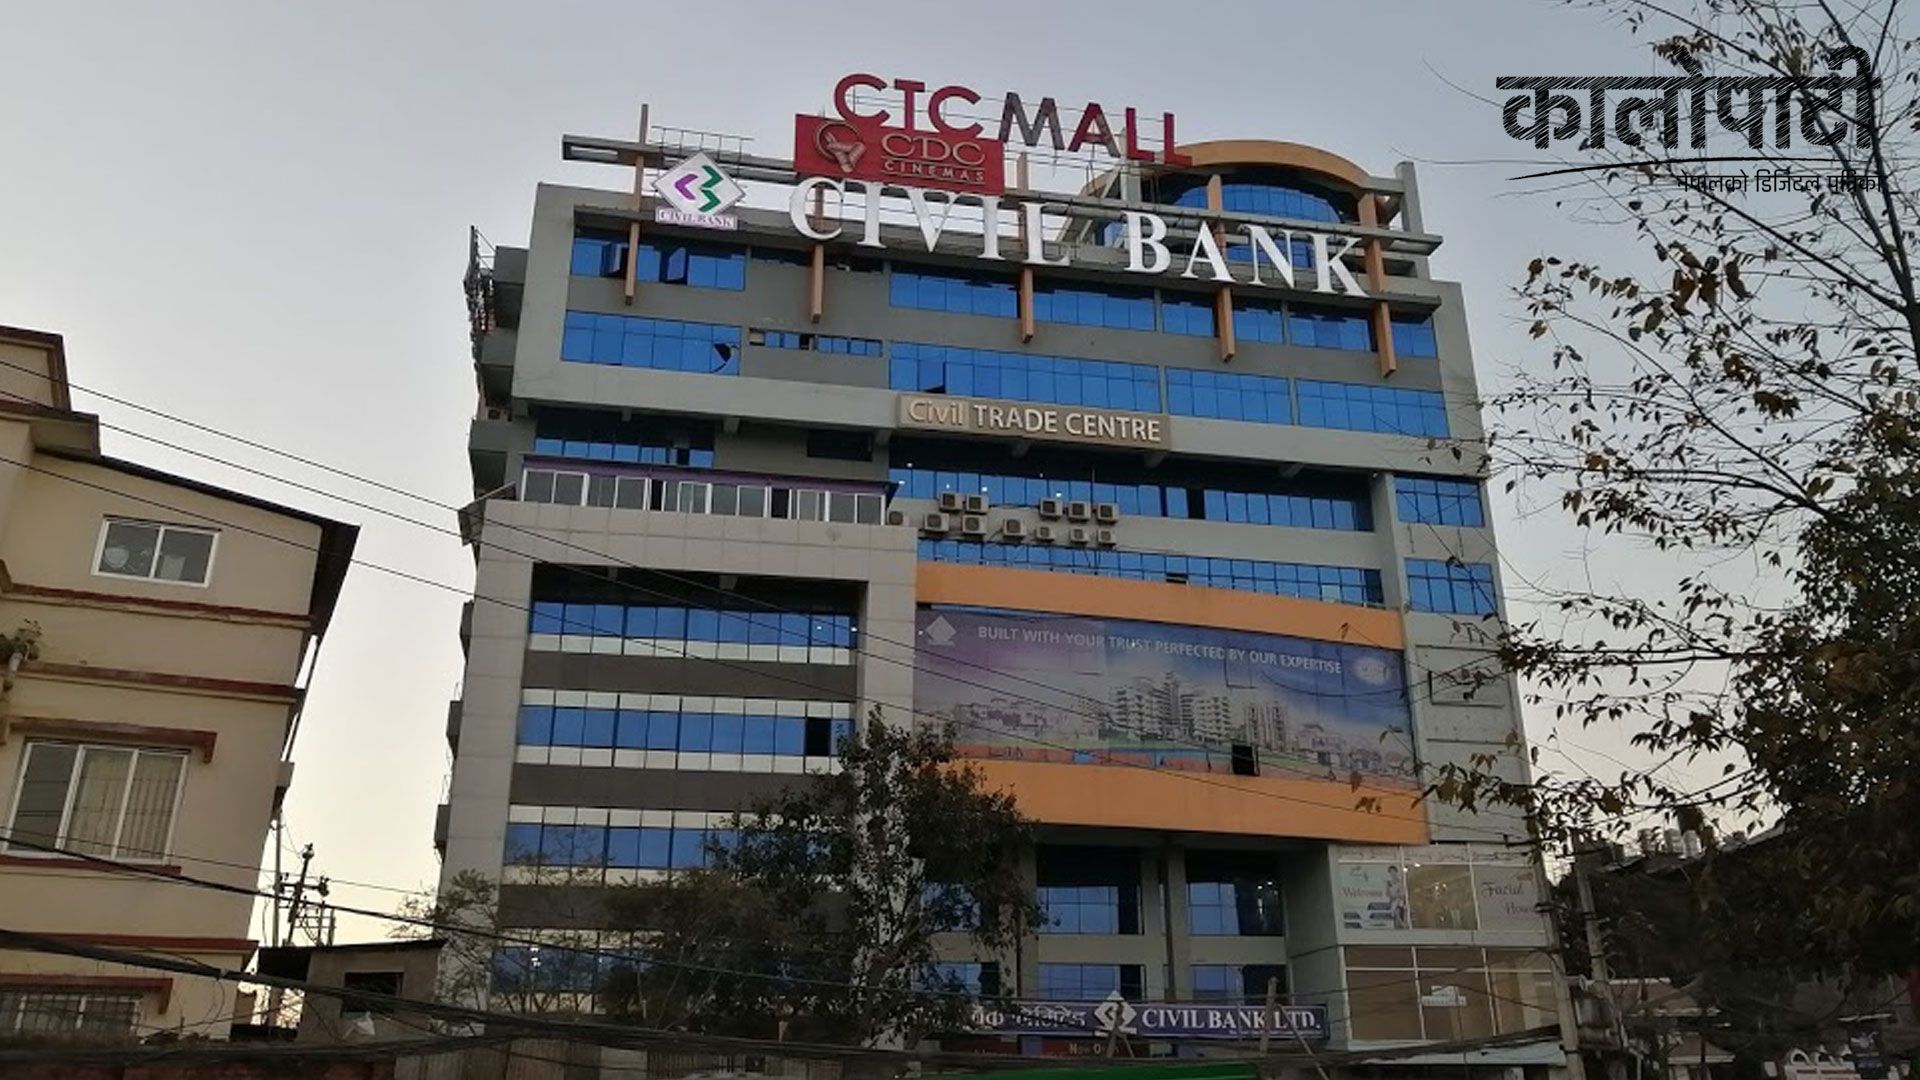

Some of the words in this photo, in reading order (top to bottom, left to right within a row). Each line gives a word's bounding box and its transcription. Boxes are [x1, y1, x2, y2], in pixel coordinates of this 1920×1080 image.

[834, 73, 984, 137] CTC
[999, 92, 1191, 165] MALL
[882, 133, 985, 165] CDC
[885, 161, 984, 181] CINEMAS
[660, 211, 695, 223] CIVIL
[697, 214, 732, 227] BANK
[789, 177, 1070, 266] CIVIL
[1120, 211, 1370, 298] BANK
[910, 400, 963, 425] Civil
[974, 404, 1058, 433] TRADE
[1066, 412, 1161, 442] CENTRE
[978, 626, 1018, 641] BUILT
[1022, 629, 1060, 644] WITH
[1063, 632, 1105, 648] YOUR
[1108, 636, 1153, 651] TRUST
[1156, 640, 1225, 660] PERFECTED
[1229, 648, 1245, 661] BY
[1249, 650, 1277, 665] OUR
[1280, 654, 1342, 674] EXPERTISE
[1142, 1009, 1205, 1029] CIVIL
[1209, 1009, 1266, 1029] BANK
[1274, 1011, 1321, 1029] LTD.
